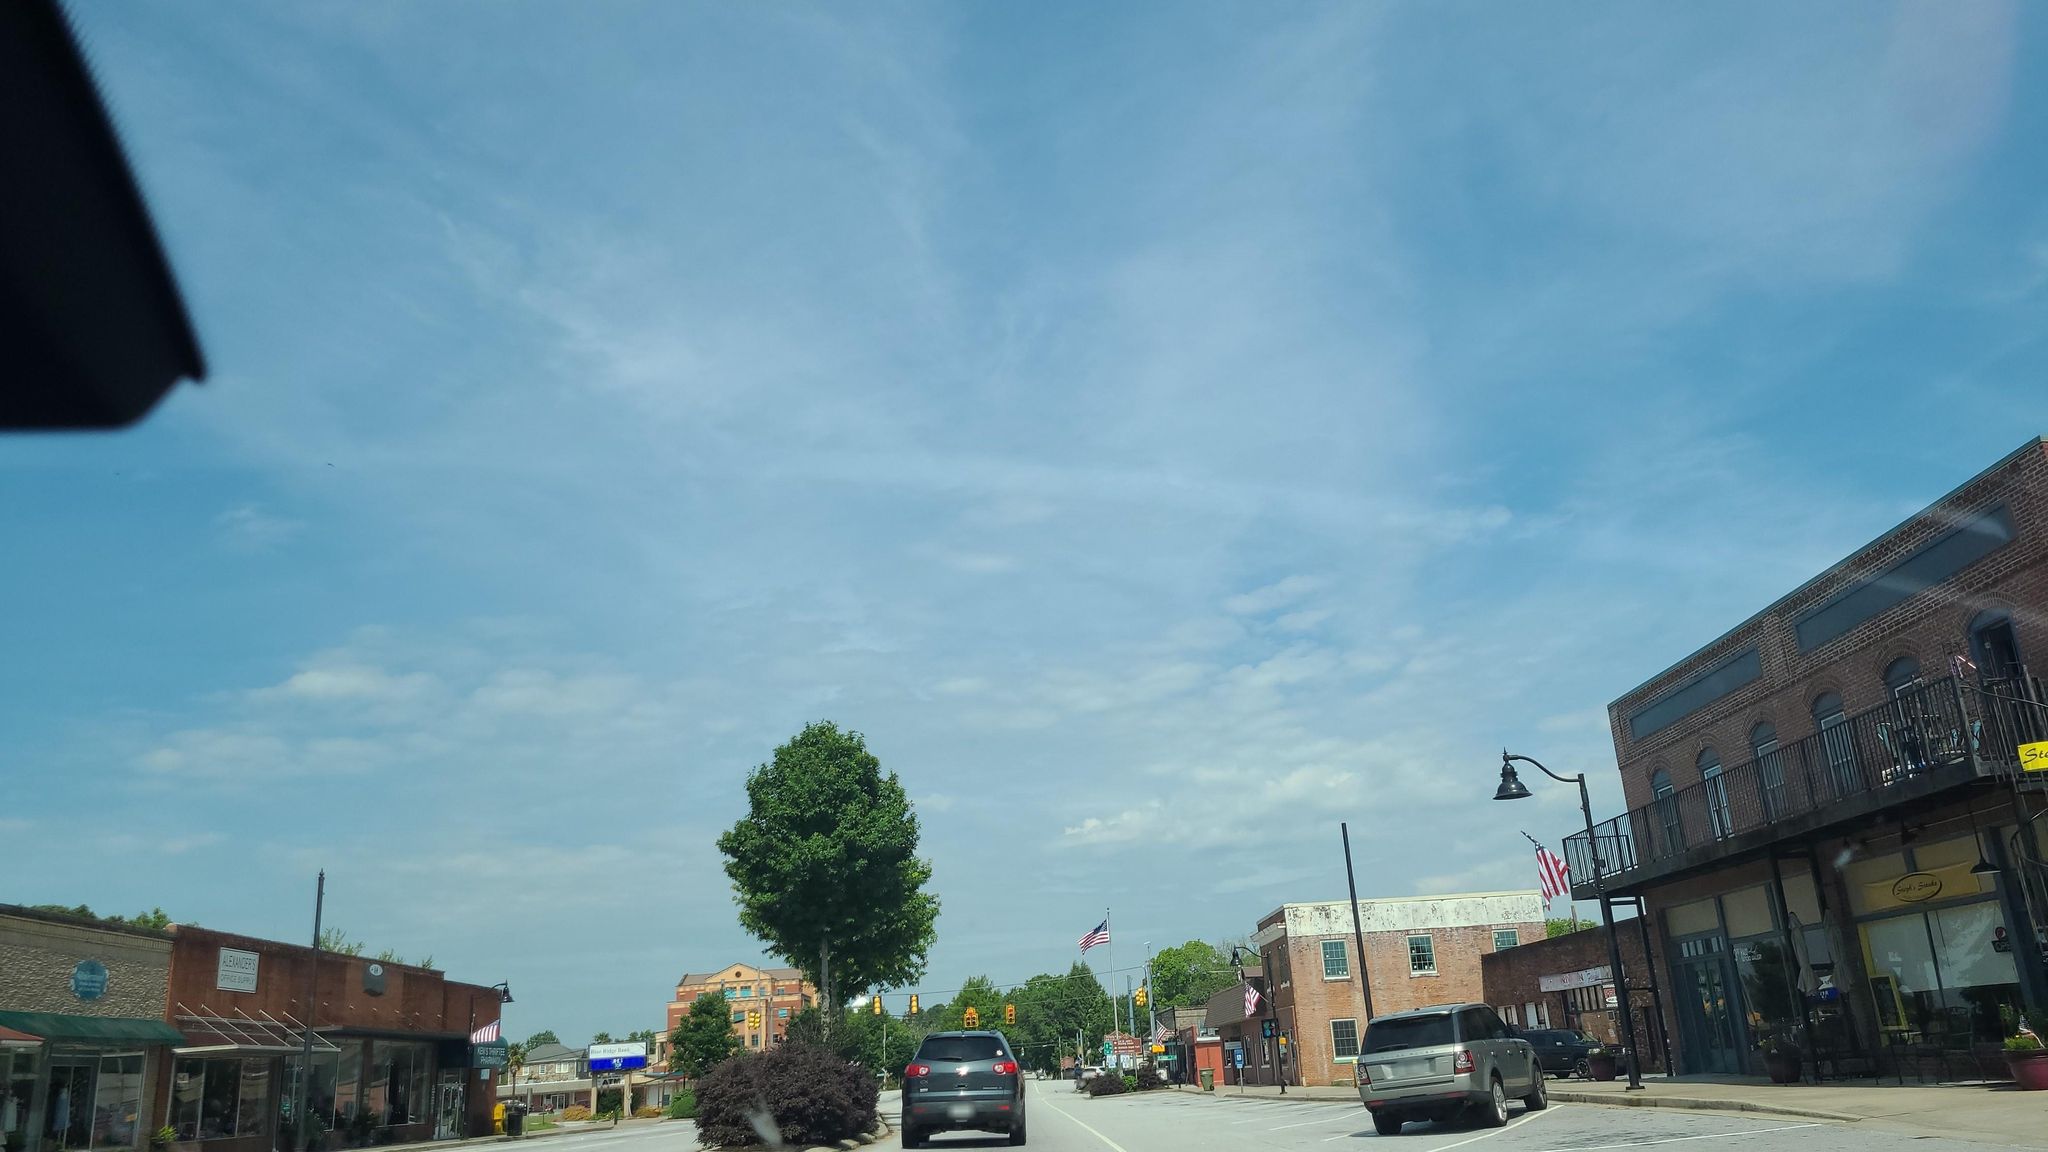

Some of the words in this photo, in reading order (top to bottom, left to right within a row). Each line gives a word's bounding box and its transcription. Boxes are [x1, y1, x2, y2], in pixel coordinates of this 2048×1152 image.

[222, 954, 256, 971] ALEXANDER'S
[603, 1047, 617, 1055] Ridge
[602, 1078, 621, 1086] ATM
